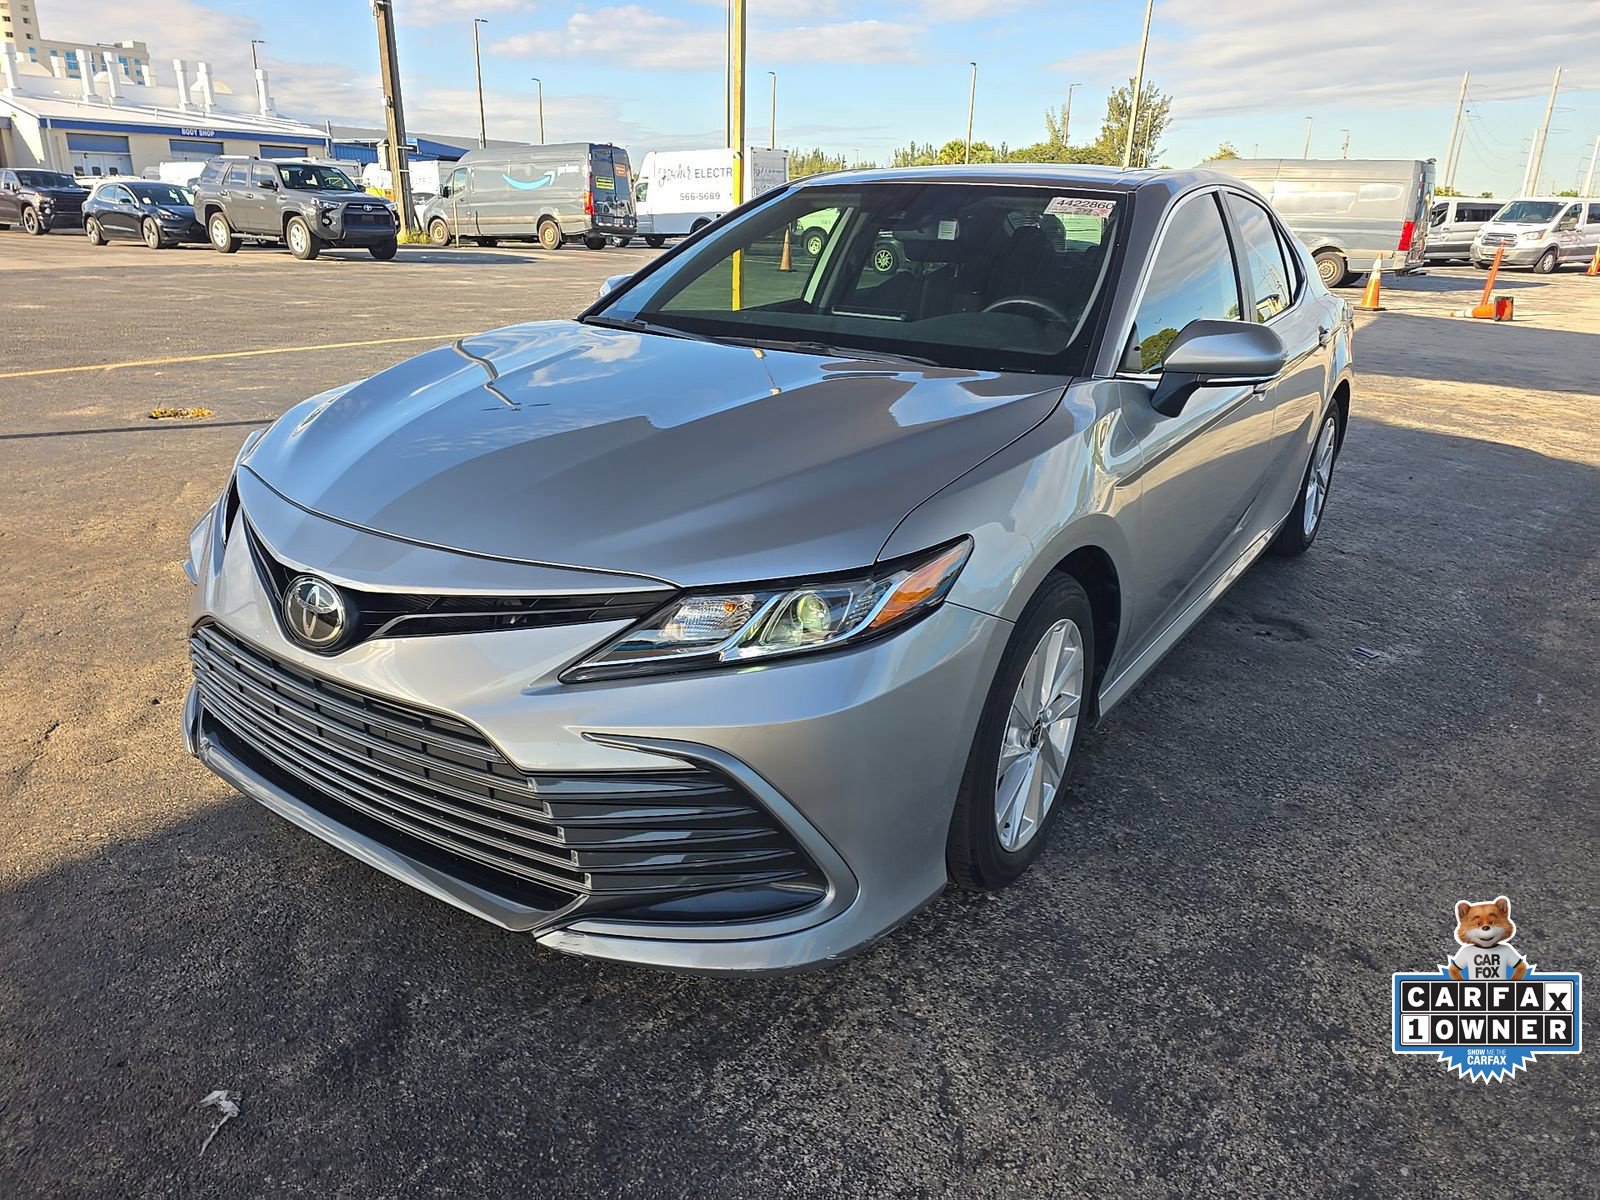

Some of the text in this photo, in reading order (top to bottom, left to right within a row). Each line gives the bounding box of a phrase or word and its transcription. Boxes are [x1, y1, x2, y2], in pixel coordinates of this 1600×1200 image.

[199, 129, 215, 137] SHOP
[694, 167, 733, 179] ELECTR
[1056, 199, 1114, 209] 4422860
